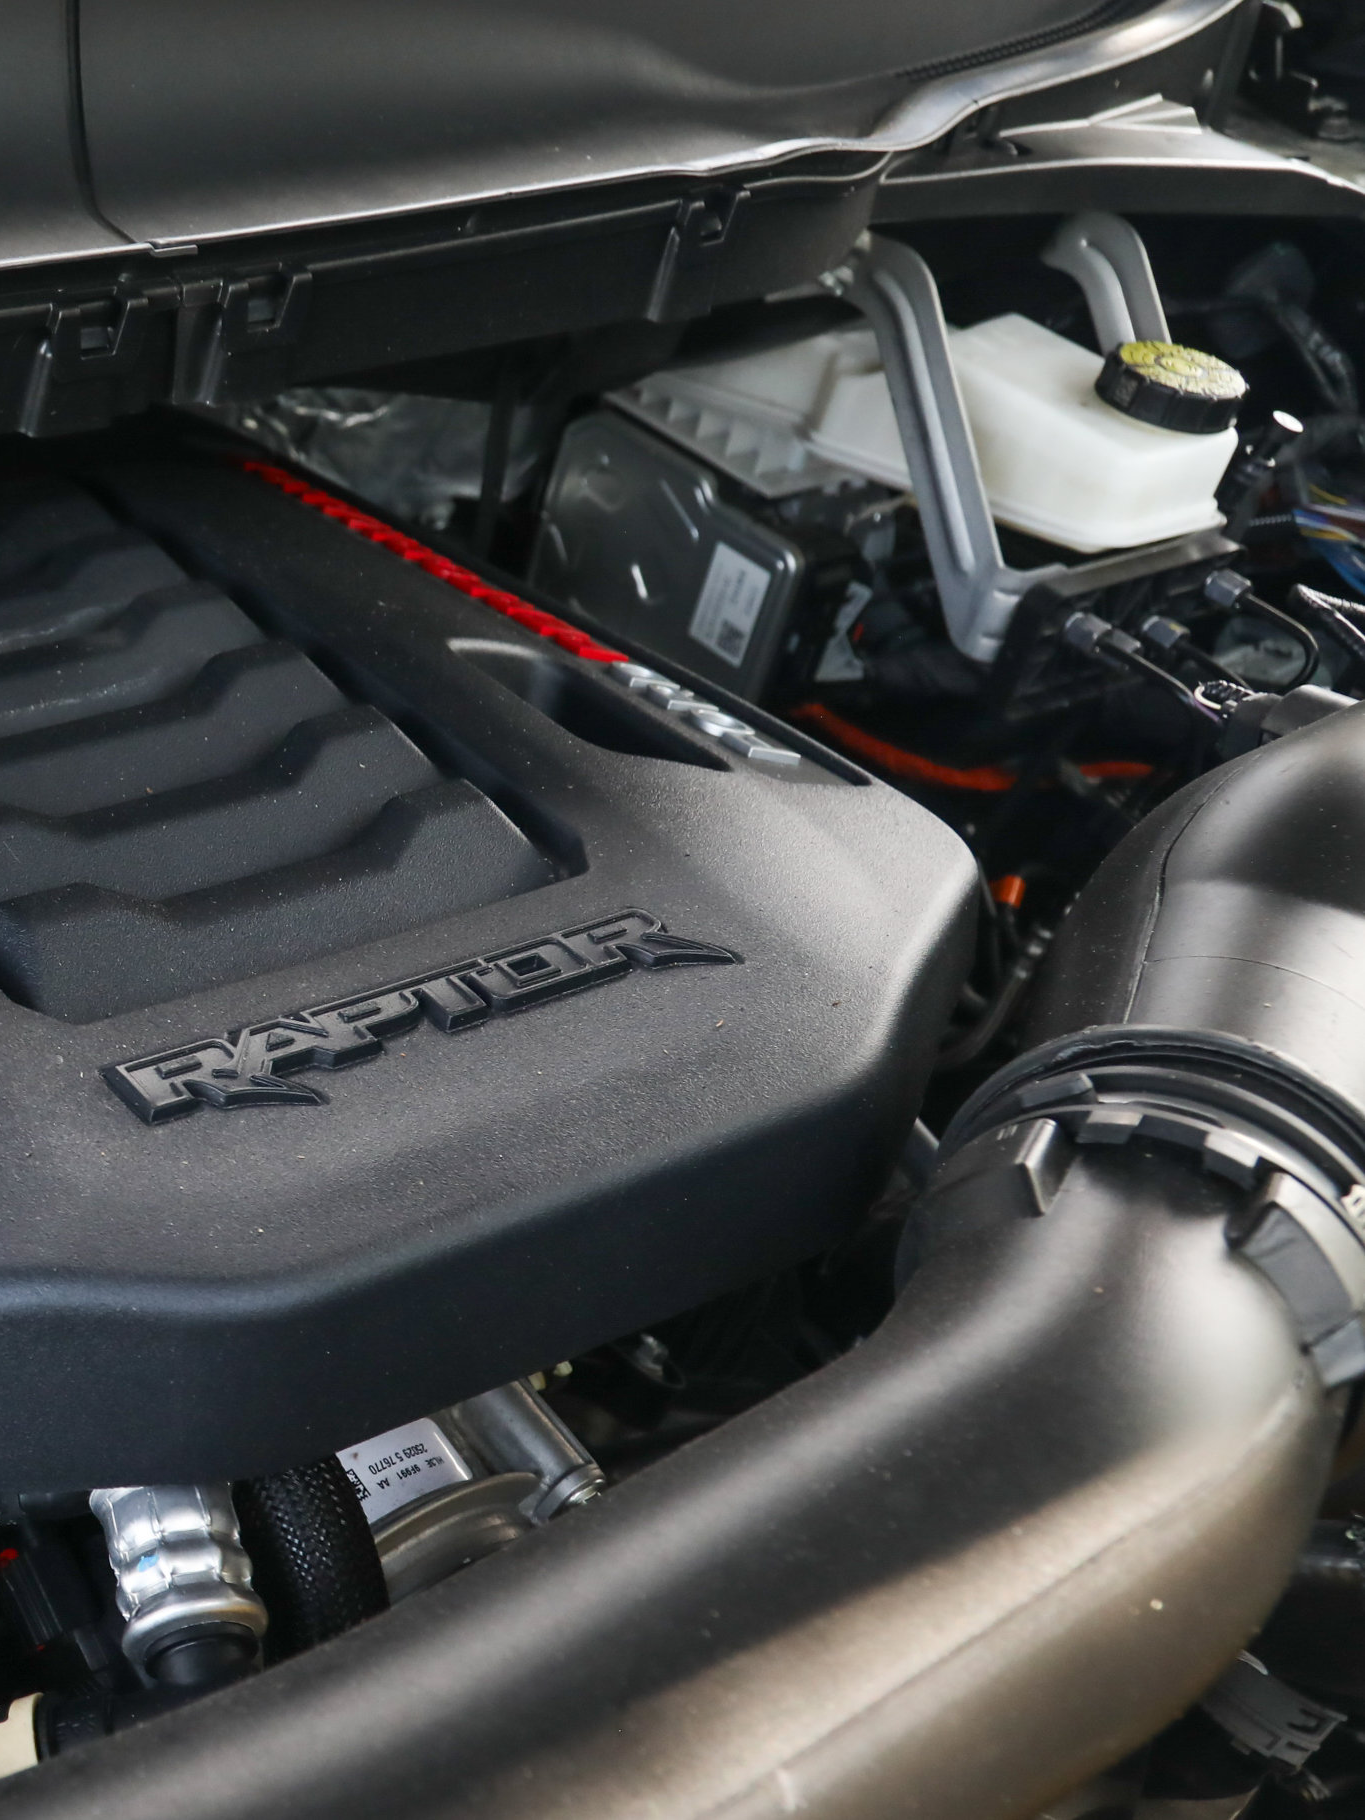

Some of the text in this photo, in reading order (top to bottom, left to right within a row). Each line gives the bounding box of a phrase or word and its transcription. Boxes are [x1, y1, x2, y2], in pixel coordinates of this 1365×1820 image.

[99, 907, 745, 1124] RAPTOR
[368, 1456, 397, 1475] 76770
[396, 1464, 421, 1480] 9F991
[377, 1477, 391, 1490] AA
